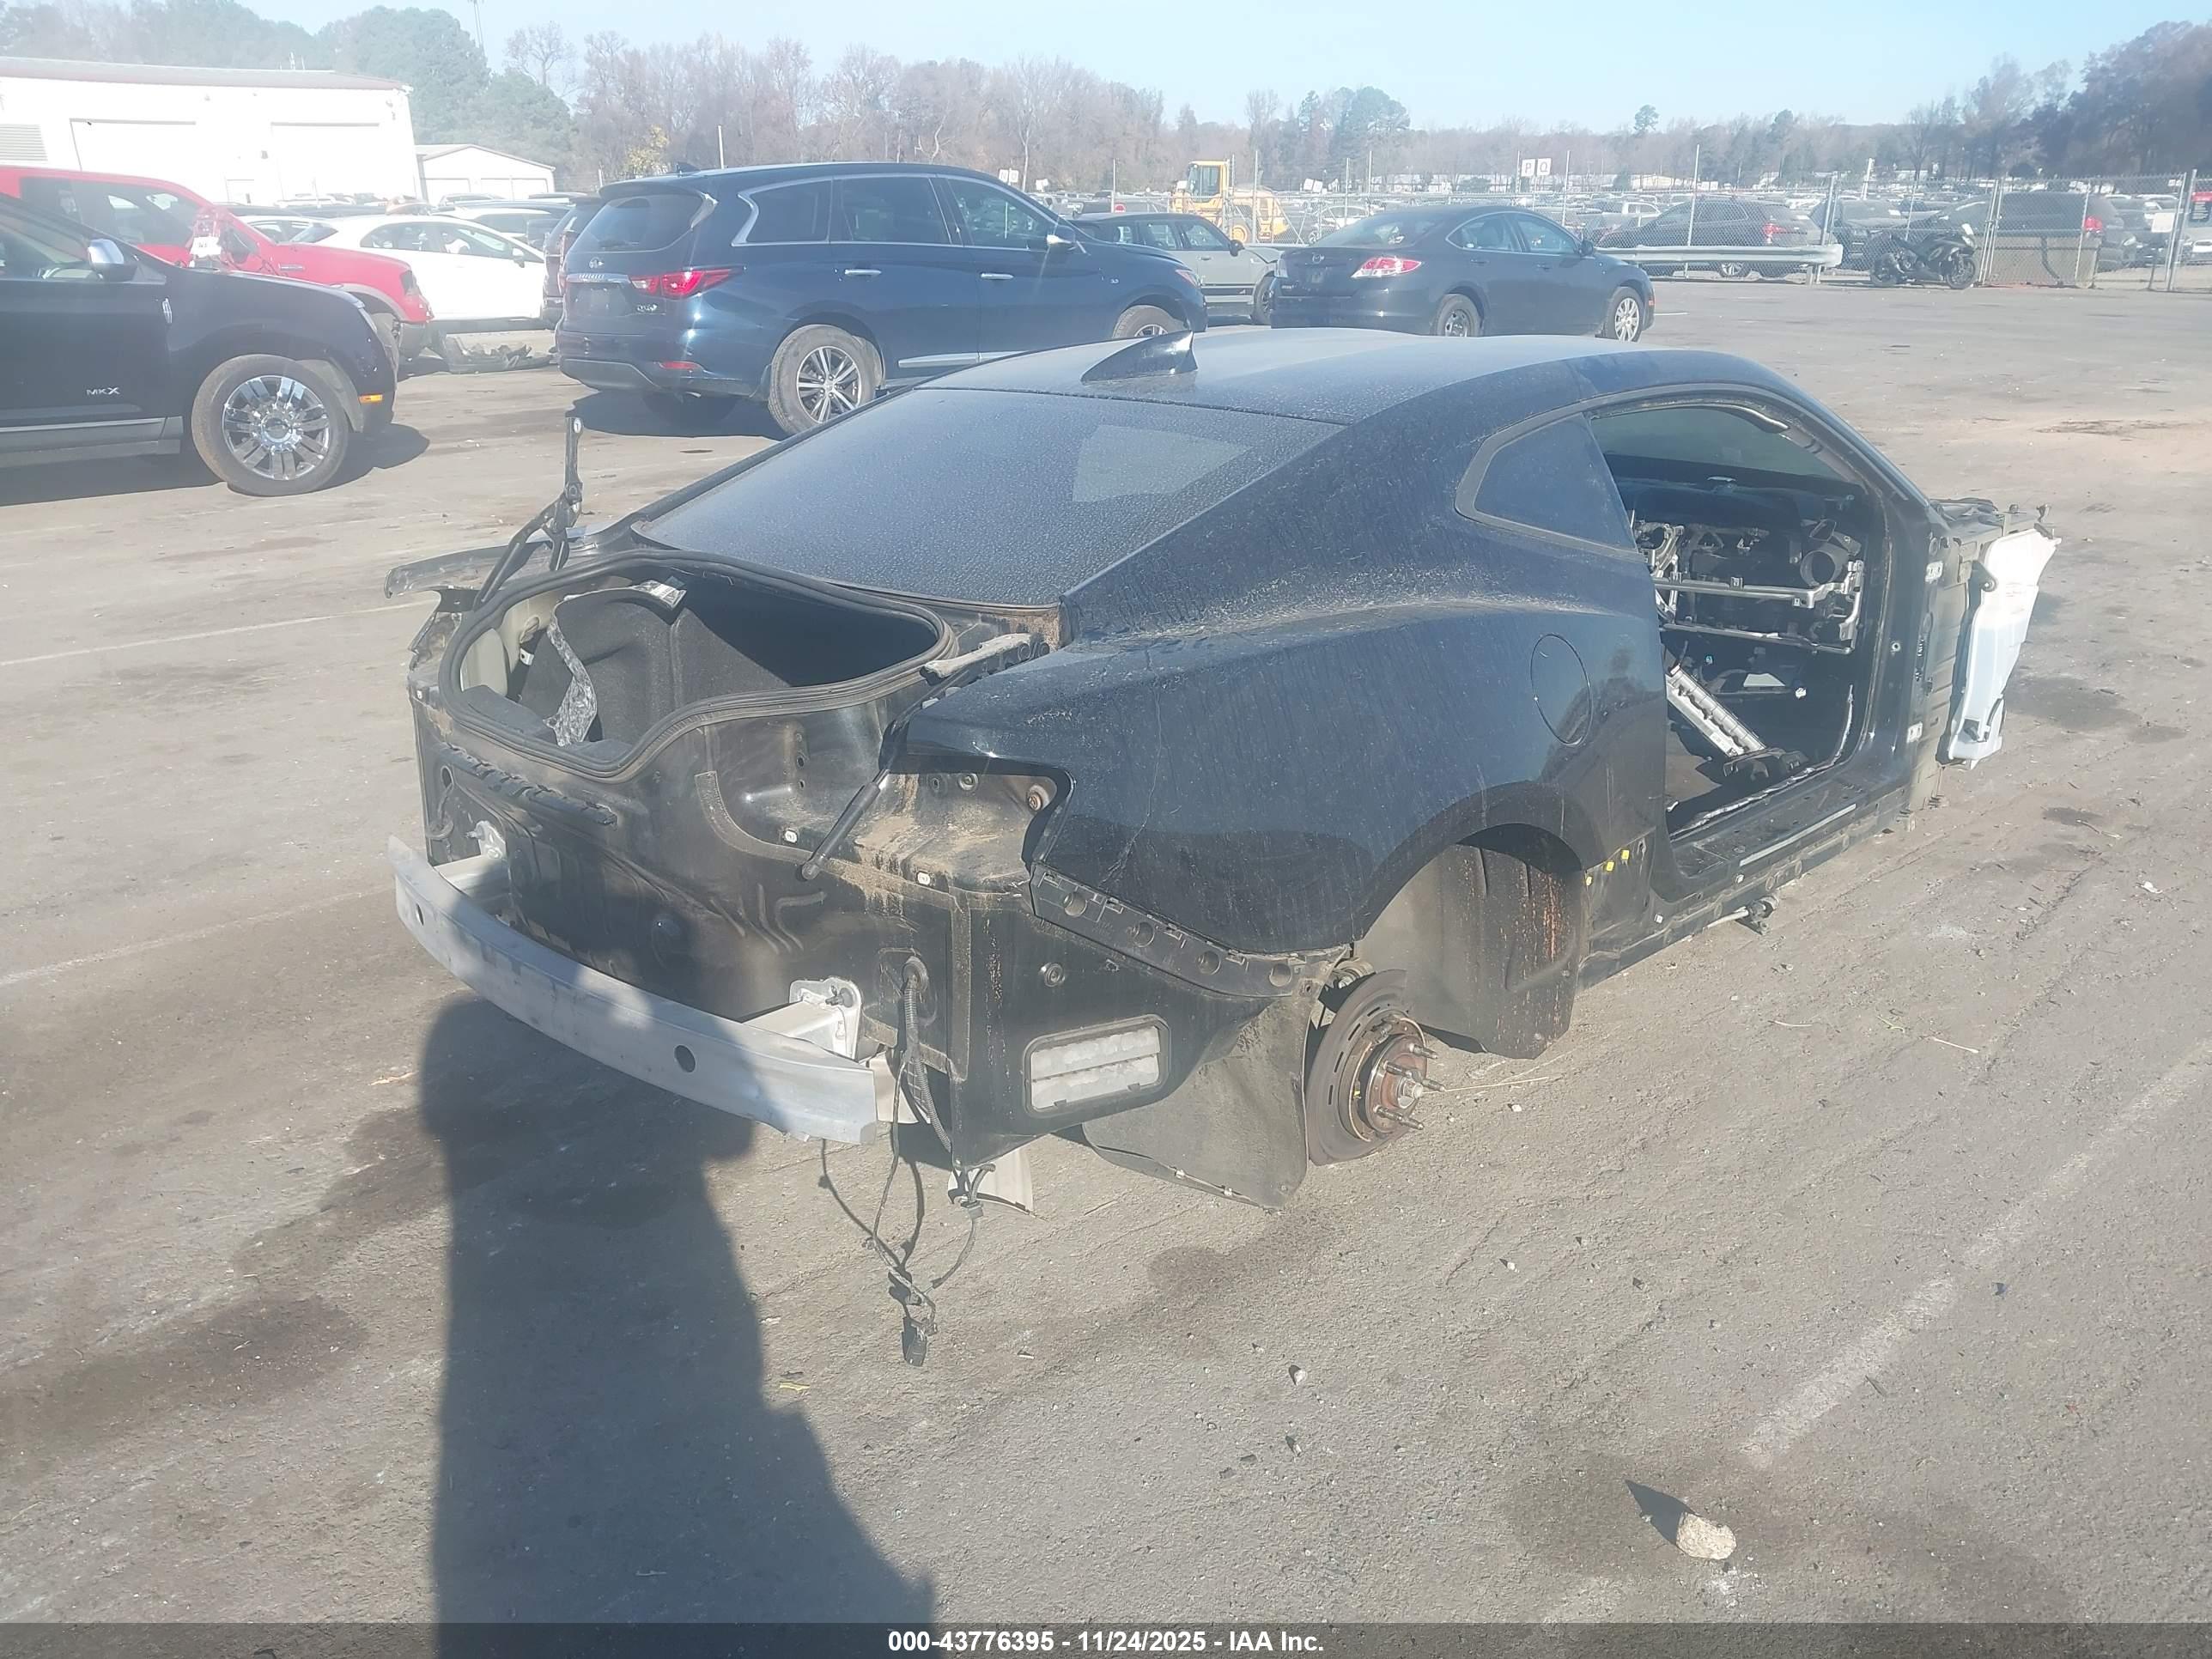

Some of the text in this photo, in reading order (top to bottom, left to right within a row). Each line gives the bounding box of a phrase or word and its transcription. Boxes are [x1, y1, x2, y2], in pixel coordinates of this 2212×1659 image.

[1524, 162, 1532, 173] P
[1539, 161, 1548, 173] Q
[86, 386, 120, 396] MKX
